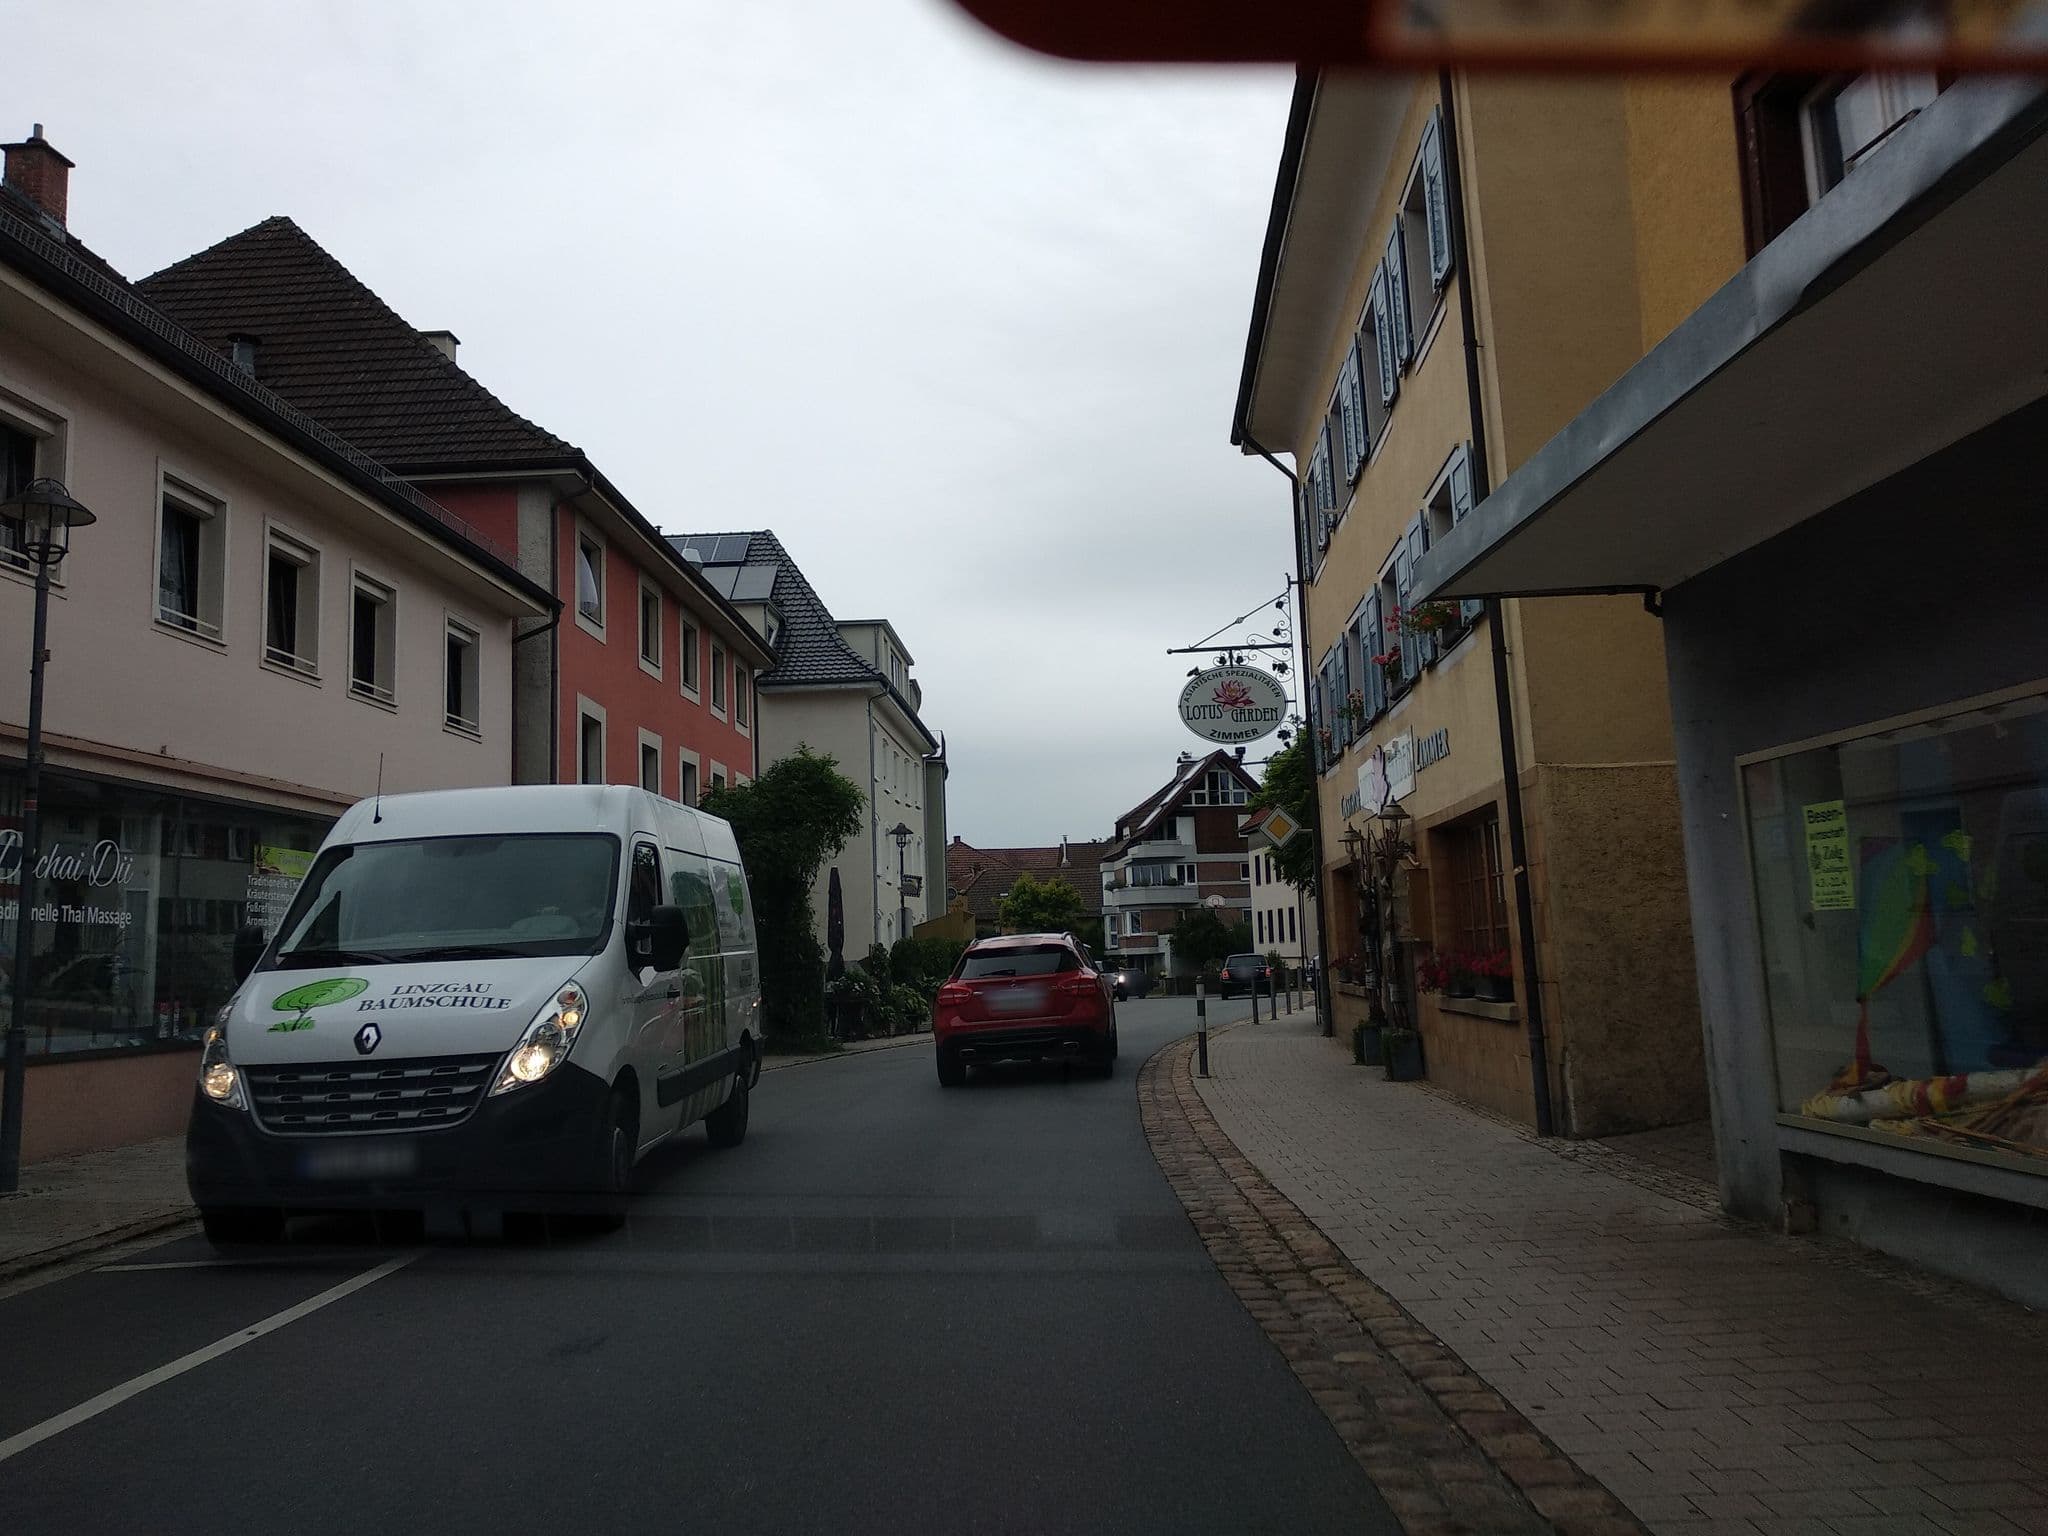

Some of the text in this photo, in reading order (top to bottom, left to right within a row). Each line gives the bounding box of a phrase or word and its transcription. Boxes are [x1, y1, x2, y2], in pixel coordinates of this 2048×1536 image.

[1184, 670, 1281, 703] ASIATISCHE SPEZIALITÄTEN
[1186, 704, 1279, 722] LOTUS GARDEN
[1209, 728, 1259, 740] ZIMMER
[88, 839, 134, 887] Dii
[61, 904, 85, 924] Thai
[87, 906, 132, 928] Massage
[391, 983, 493, 996] LINZGAU
[356, 996, 512, 1012] BAUMSCHULE
